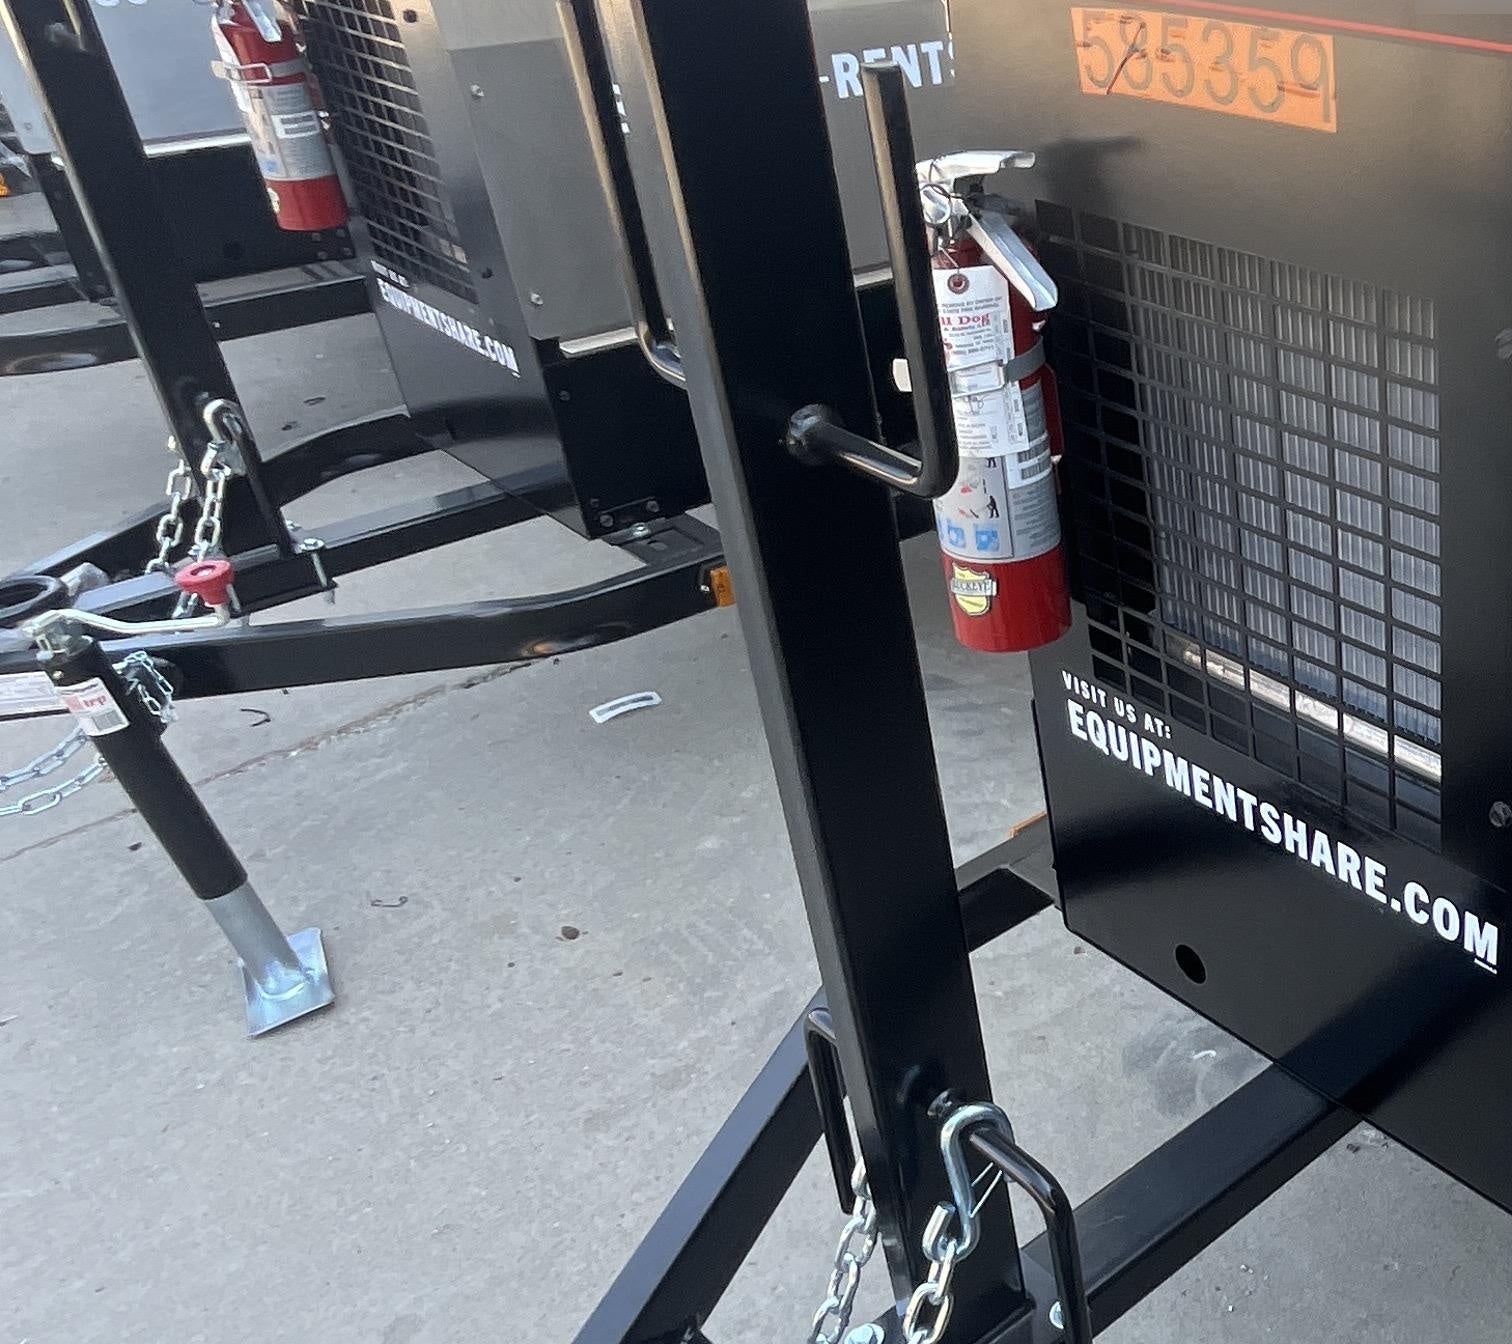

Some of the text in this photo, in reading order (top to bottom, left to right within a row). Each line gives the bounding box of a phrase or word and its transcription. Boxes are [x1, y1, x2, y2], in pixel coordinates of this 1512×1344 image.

[1082, 9, 1331, 124] 585359
[1062, 669, 1173, 740] VISIT US AT:
[1066, 698, 1499, 966] EQUIPMENTSHARE.COM
